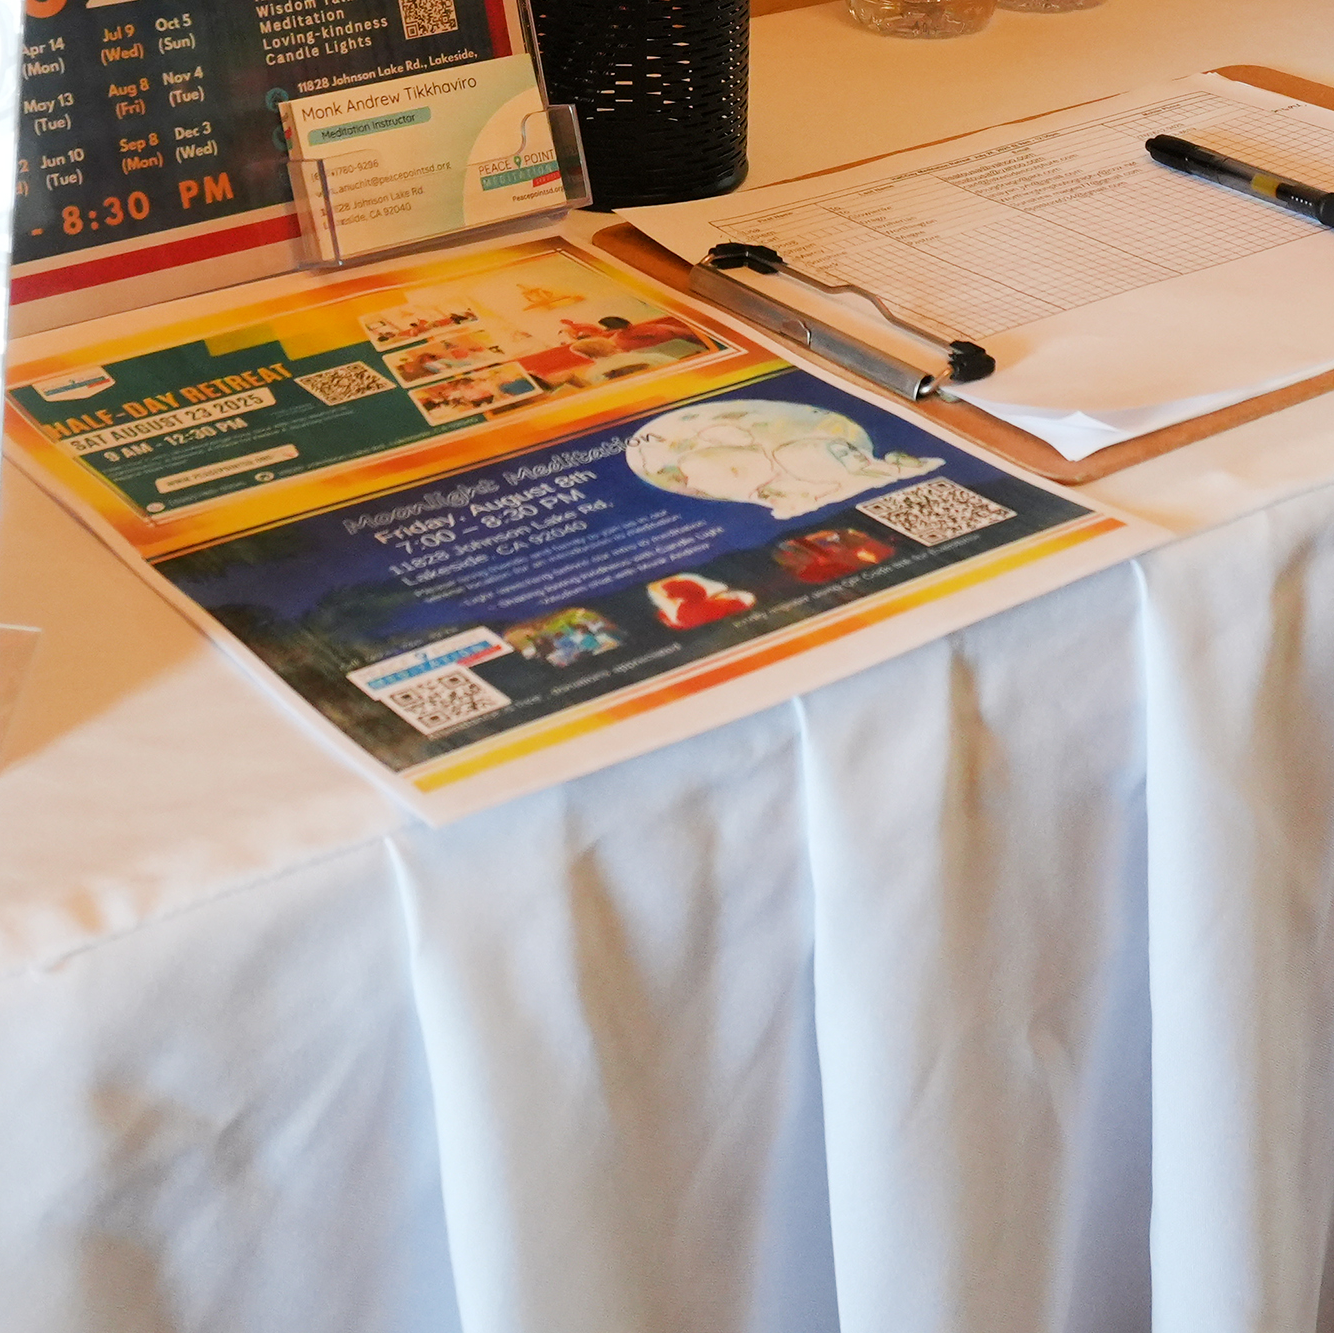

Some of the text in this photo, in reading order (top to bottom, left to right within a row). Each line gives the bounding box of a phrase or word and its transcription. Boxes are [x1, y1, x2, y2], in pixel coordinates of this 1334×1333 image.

[102, 24, 136, 43] Jul 9
[154, 13, 193, 33] Oct 5
[259, 8, 345, 35] Meditation
[263, 16, 389, 50] Loving-kindness
[21, 36, 65, 59] Apr 14
[100, 42, 145, 66] (Wed)
[158, 33, 196, 54] (Sun)
[266, 36, 373, 66] Candle Lights
[22, 57, 65, 80] (Mon)
[162, 66, 204, 86] Nov 4
[297, 48, 478, 94] 11828 Johnson Lake Rd., Lakeside,
[107, 77, 150, 98] Aug 8
[168, 85, 205, 107] (Tue)
[301, 76, 478, 122] Monk Andrew Tikkhaviro
[23, 92, 74, 115] May 13
[115, 98, 146, 120] (Fri)
[34, 114, 72, 136] (Tue)
[174, 121, 212, 141] Dec 3
[321, 113, 416, 140] Meditation Instructor
[119, 132, 159, 154] Sep 8
[175, 139, 218, 164] (Wed)
[40, 147, 85, 170] Jun 10
[121, 151, 164, 175] (Mon)
[478, 149, 555, 175] PEACE POINT
[46, 168, 83, 191] (Tue)
[62, 191, 151, 236] 8:30
[178, 172, 234, 210] PM
[42, 362, 294, 441] HALF-DAY RETREAT
[70, 392, 265, 452] SAT AUGUST 23 2025
[120, 441, 155, 460] AM
[163, 426, 218, 448] 12:30
[216, 417, 249, 433] PM
[342, 478, 500, 535] Moonlight
[502, 432, 666, 486] Meditation
[469, 482, 556, 517] August
[554, 470, 598, 488] 8th
[395, 487, 586, 555] 7:00 8:30 PM
[454, 525, 532, 557] Johnson
[531, 510, 578, 530] Lake
[496, 540, 530, 556] CA
